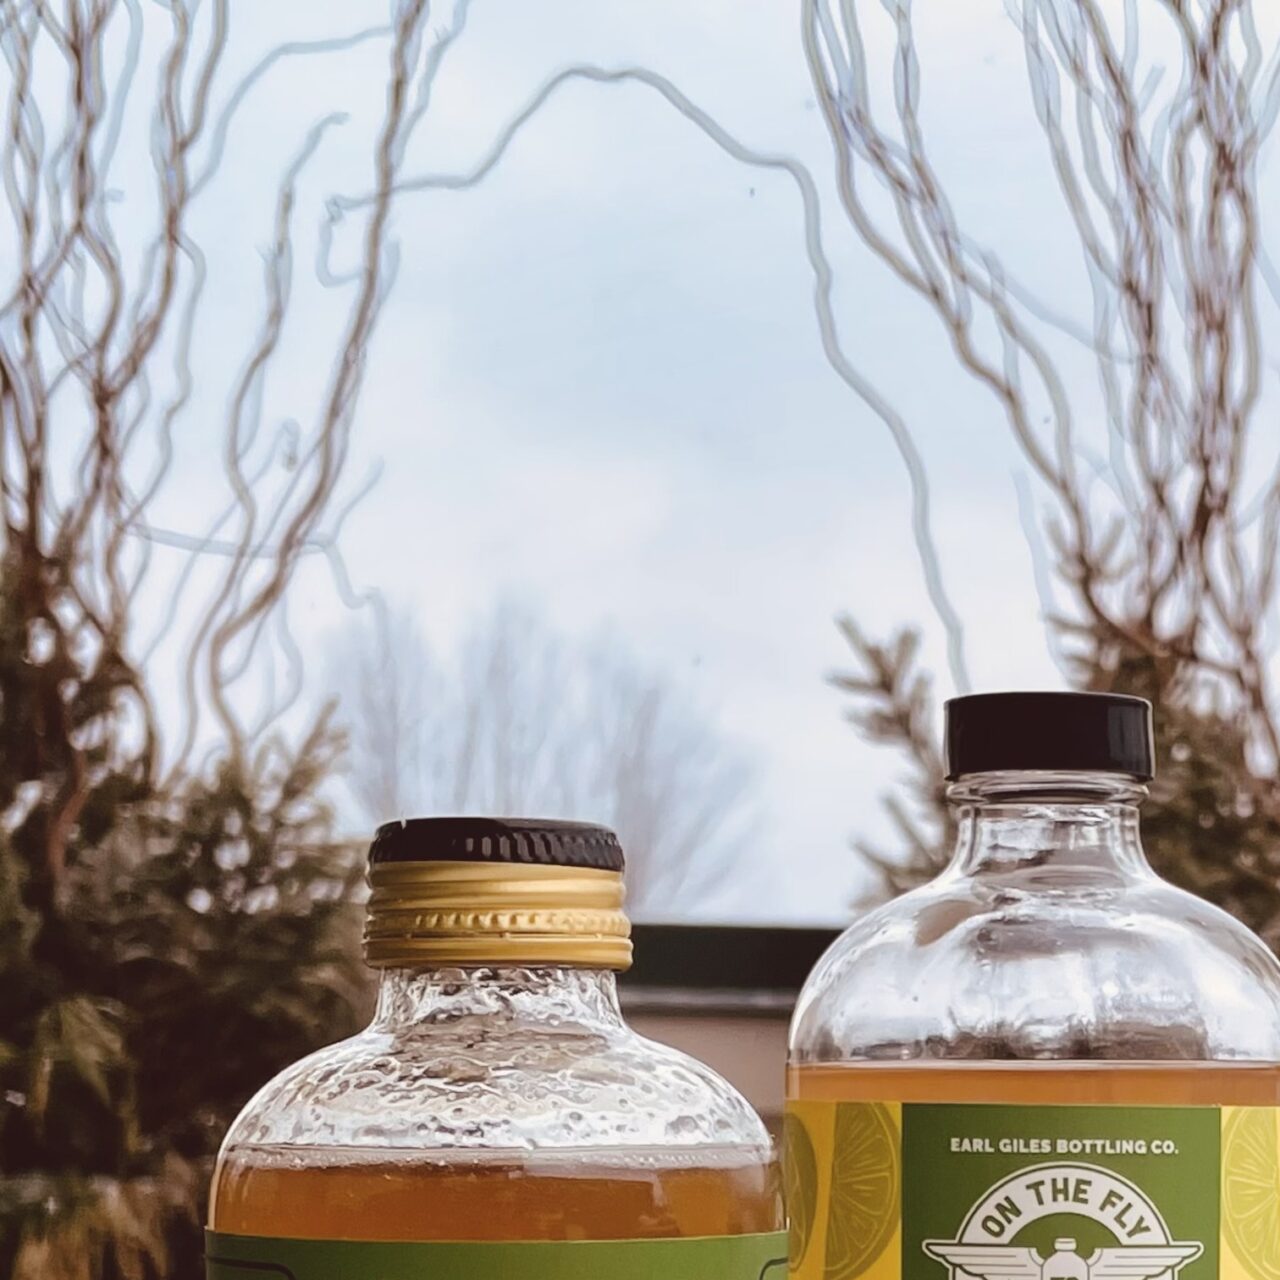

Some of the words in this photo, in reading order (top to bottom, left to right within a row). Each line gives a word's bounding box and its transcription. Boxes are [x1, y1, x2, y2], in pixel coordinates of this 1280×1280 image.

[950, 1137, 995, 1154] EARL
[998, 1138, 1052, 1155] GILES
[1055, 1138, 1147, 1155] BOTTLING
[1150, 1139, 1179, 1155] CO.
[980, 1195, 1023, 1239] ON
[1025, 1176, 1093, 1207] THE
[1099, 1188, 1152, 1240] FLY
